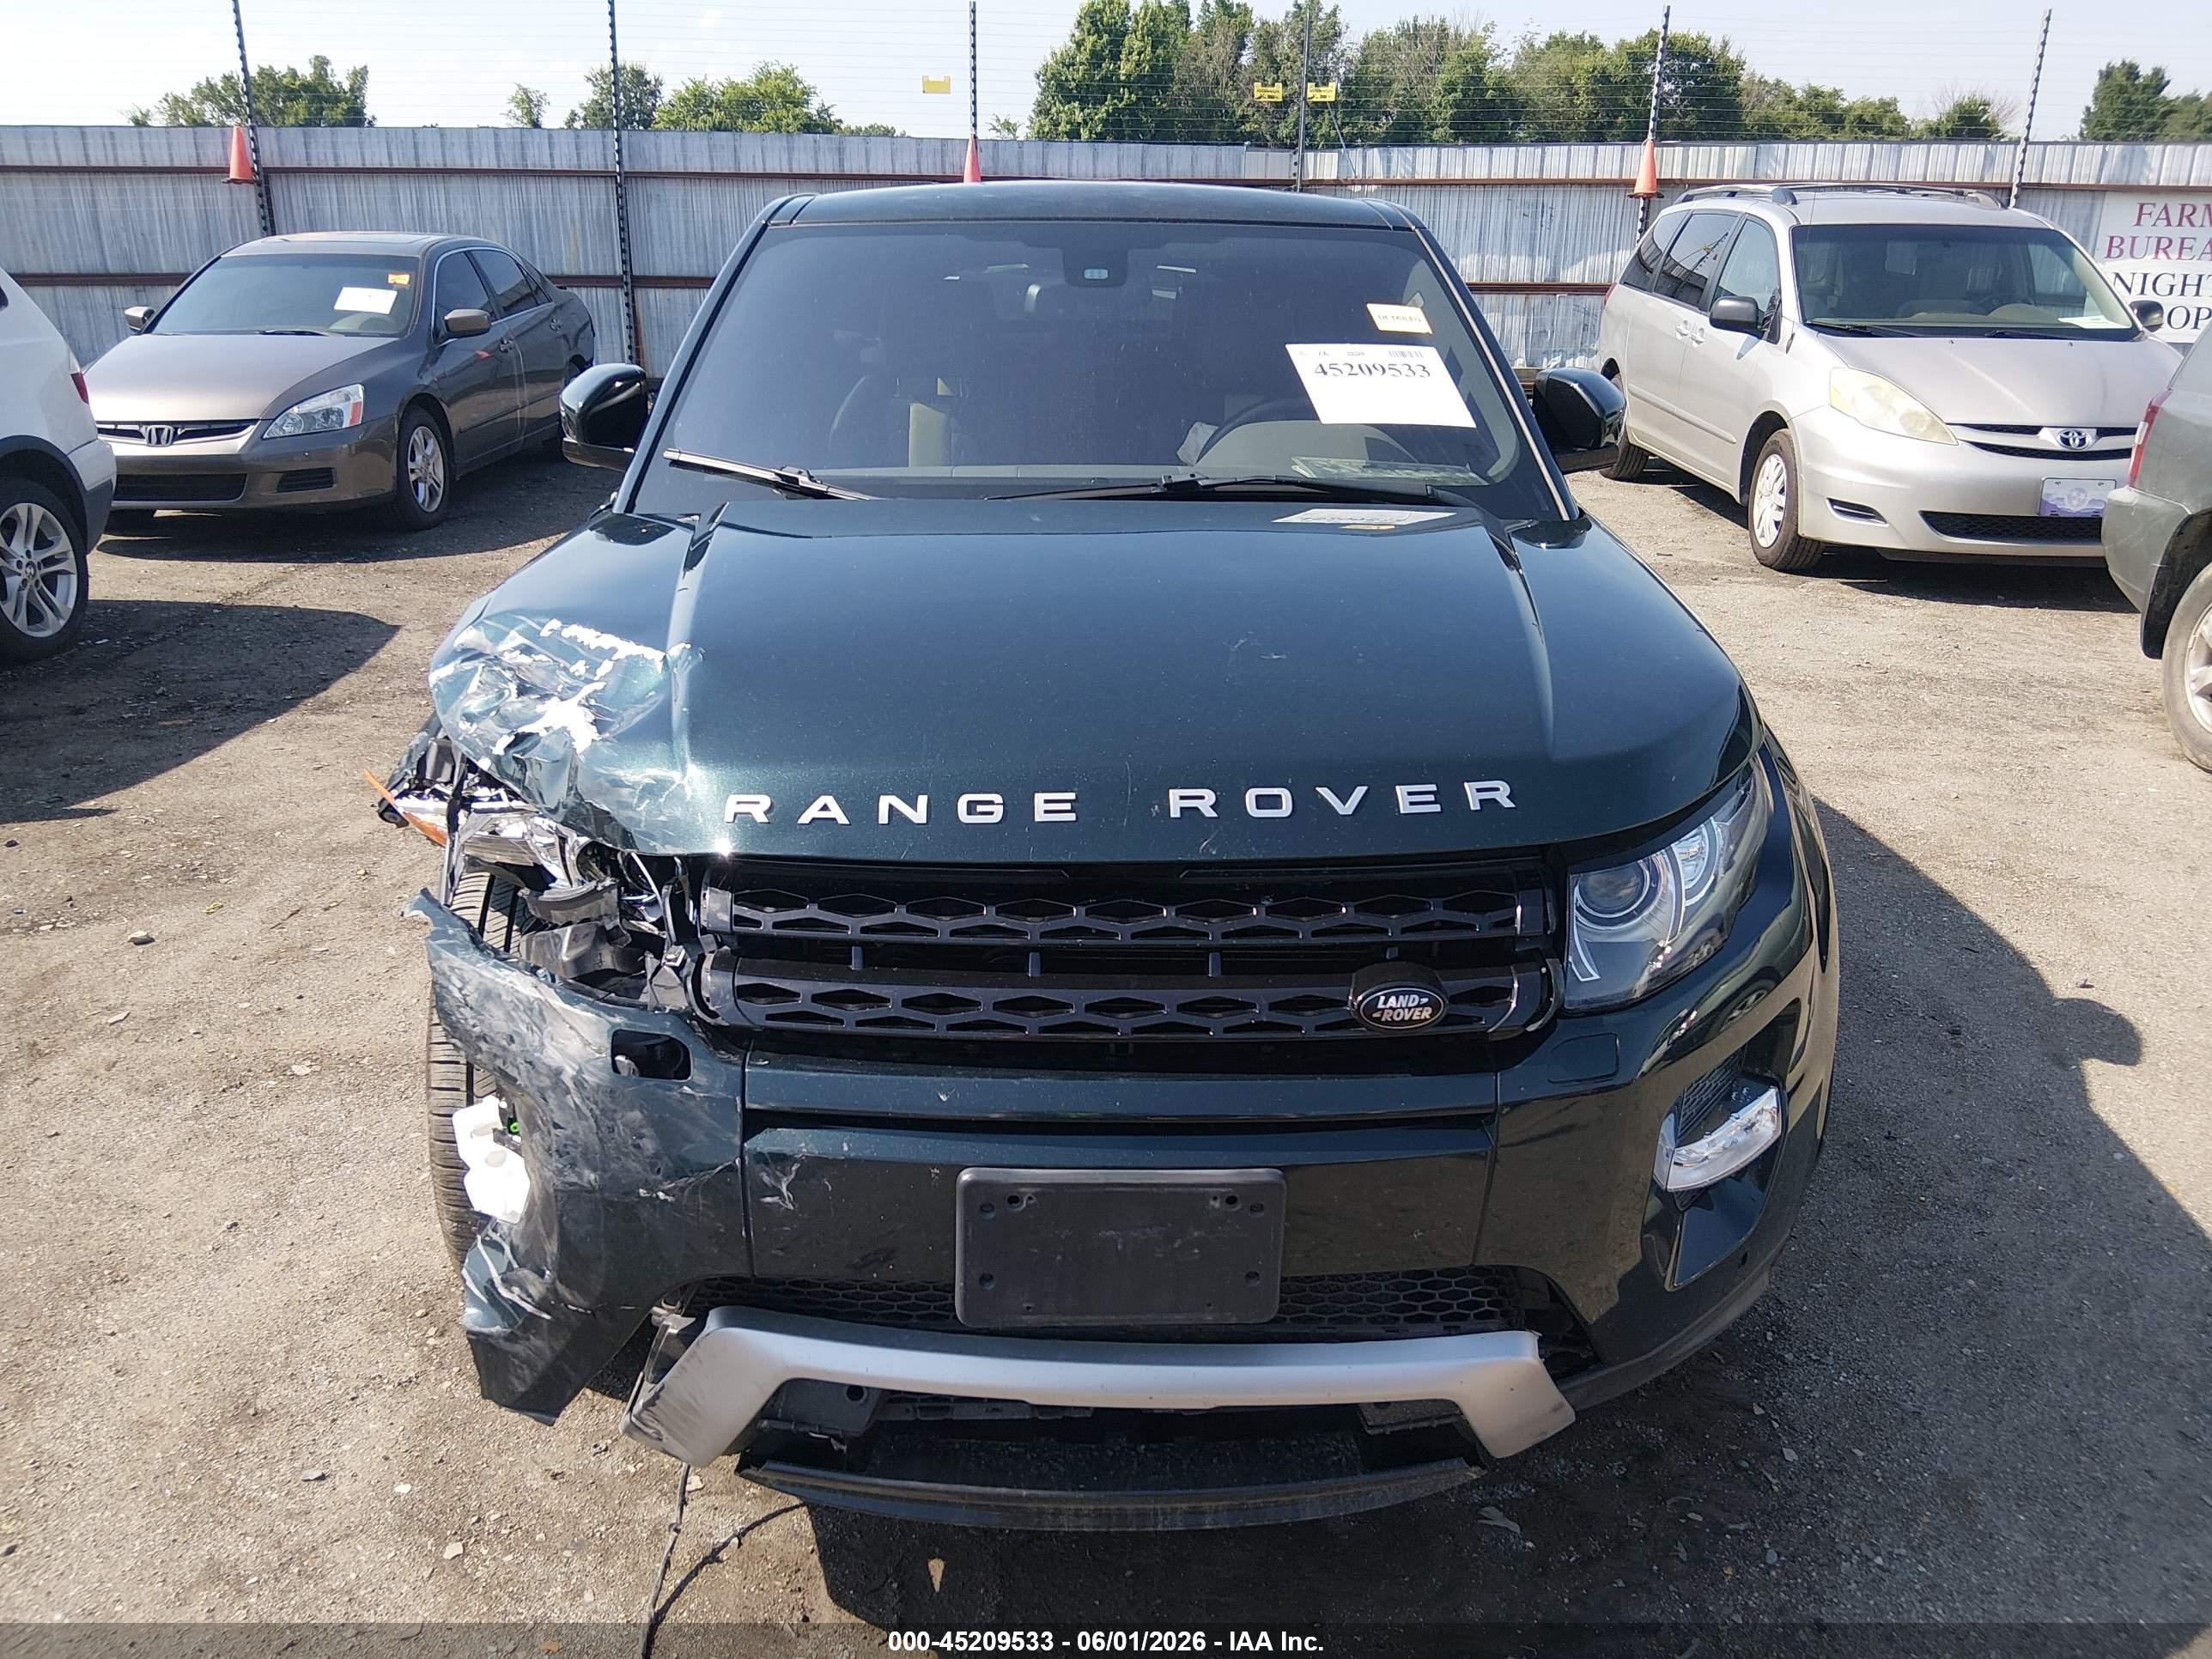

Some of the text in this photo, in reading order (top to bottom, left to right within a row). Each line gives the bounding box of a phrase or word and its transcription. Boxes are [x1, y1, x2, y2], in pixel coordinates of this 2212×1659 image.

[2110, 271, 2212, 297] NIGH
[1314, 362, 1431, 378] 45209533
[723, 780, 1516, 825] RANGE ROVER
